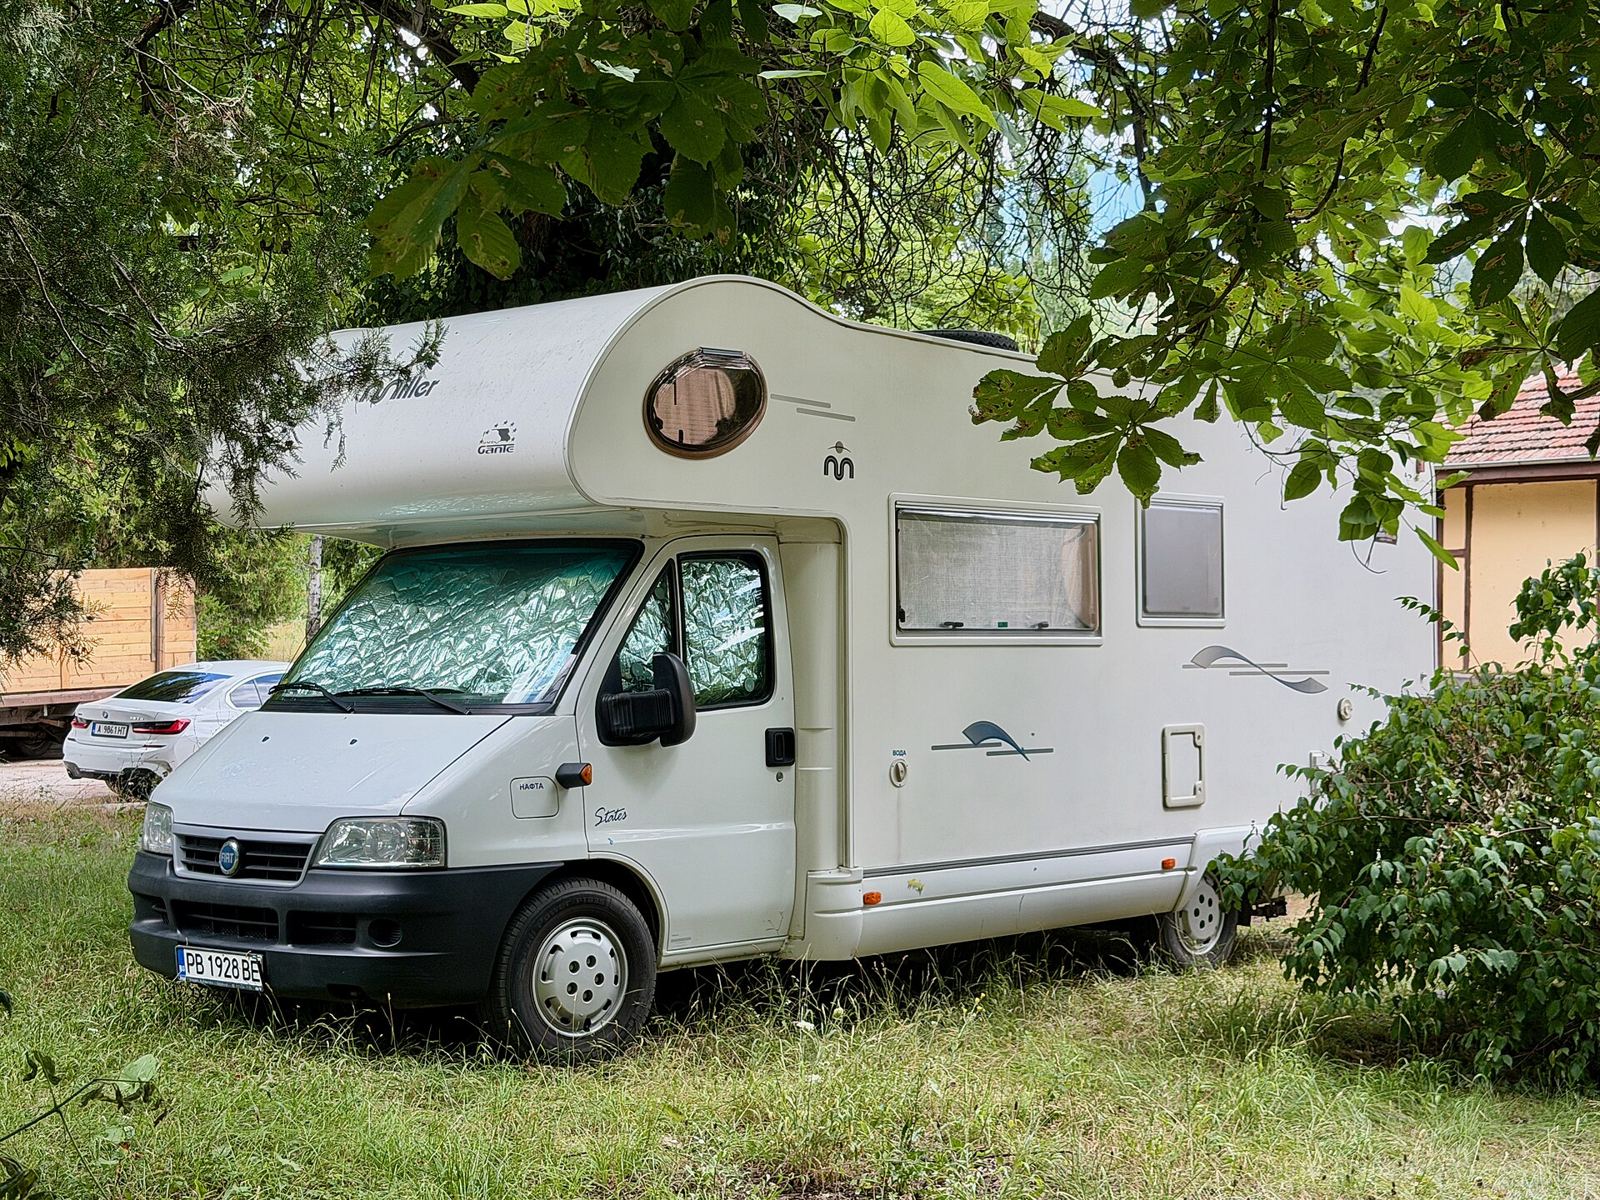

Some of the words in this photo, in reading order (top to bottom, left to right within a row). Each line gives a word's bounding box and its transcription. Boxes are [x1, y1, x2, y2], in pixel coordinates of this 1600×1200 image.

[519, 782, 545, 791] НАФТА
[594, 806, 628, 827] States
[186, 952, 205, 975] PB
[207, 955, 240, 980] 1928
[241, 959, 262, 983] BE
